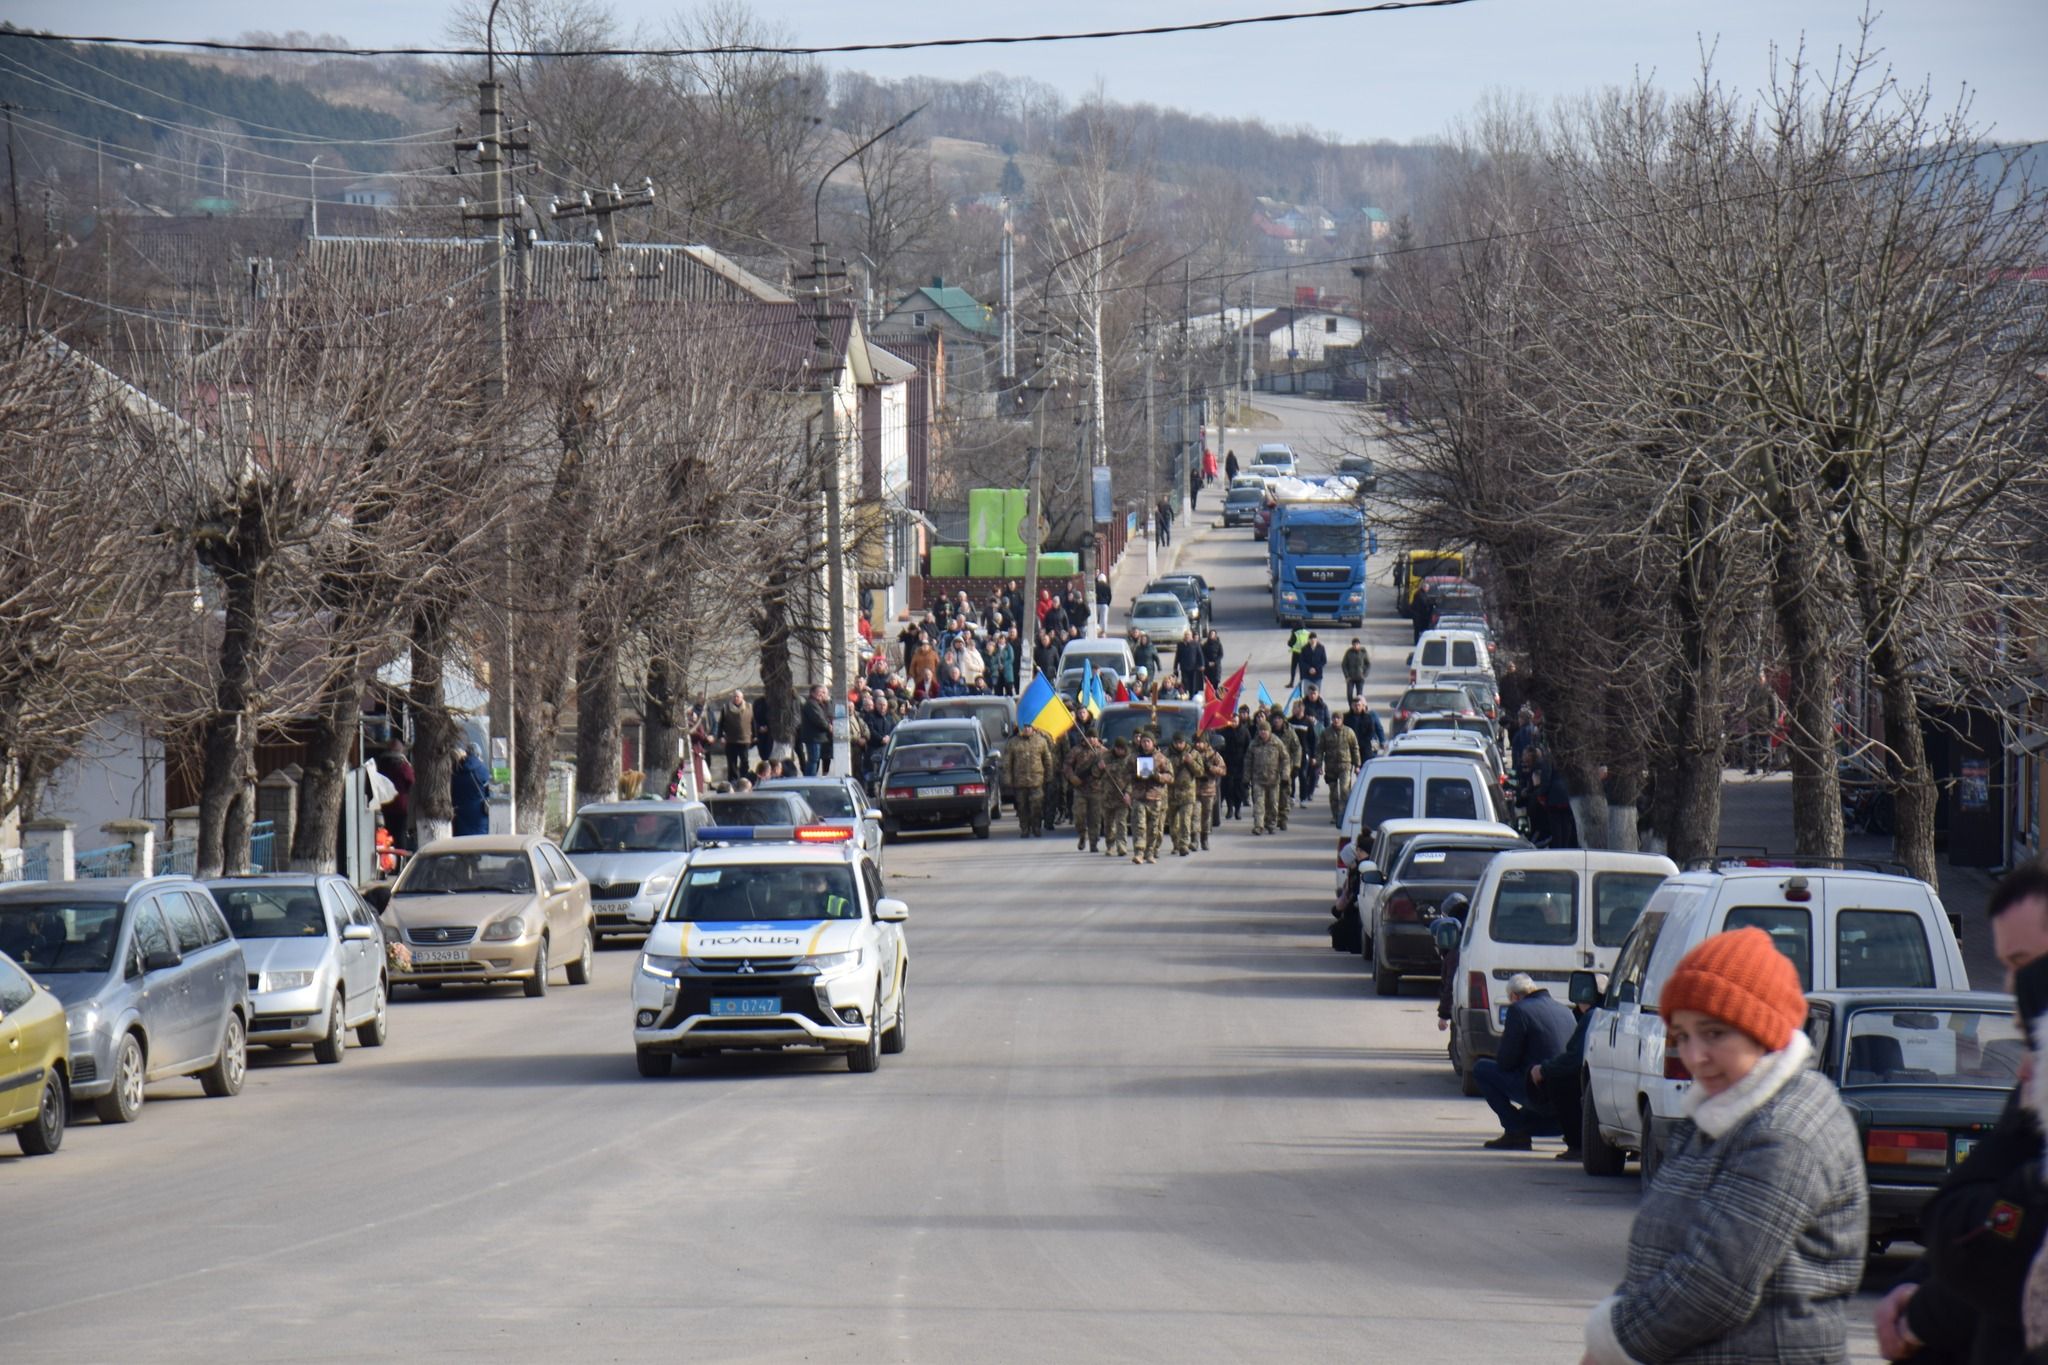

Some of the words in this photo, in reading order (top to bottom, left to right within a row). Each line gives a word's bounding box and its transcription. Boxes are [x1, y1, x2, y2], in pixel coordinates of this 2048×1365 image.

[700, 936, 799, 946] ПОЛІЦІЯ
[431, 951, 452, 961] 5249
[742, 999, 774, 1012] 0747
